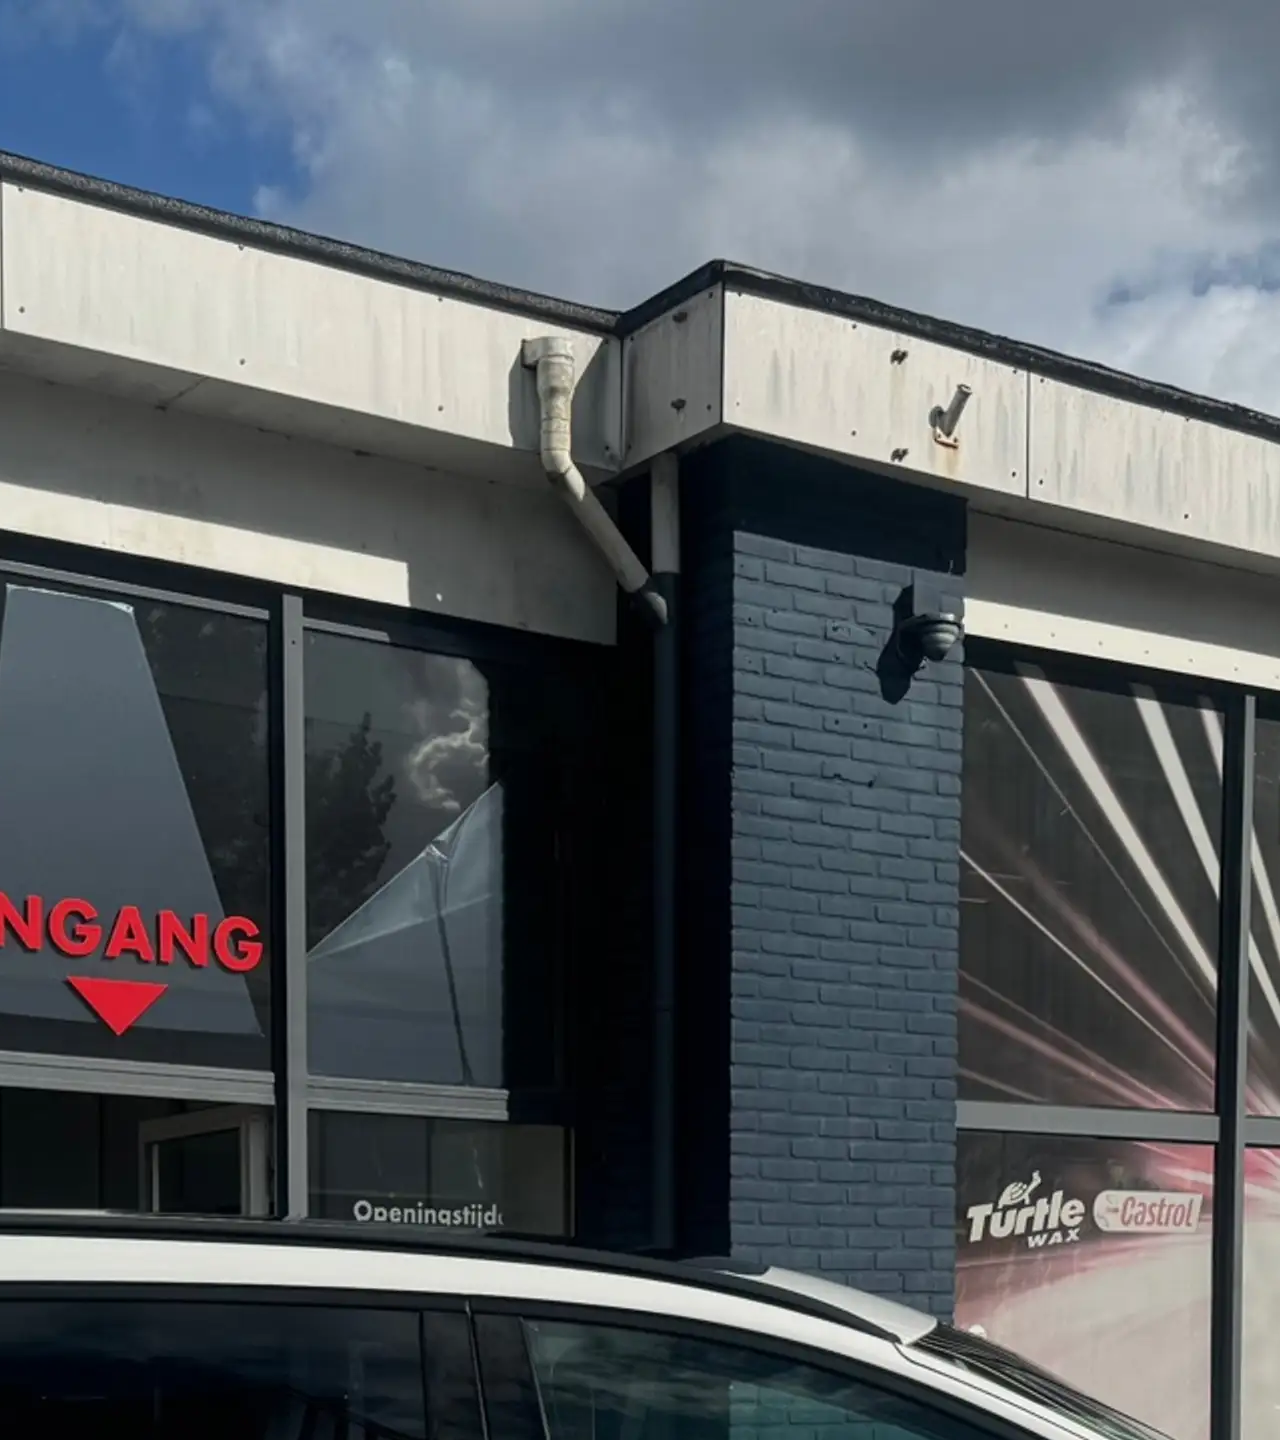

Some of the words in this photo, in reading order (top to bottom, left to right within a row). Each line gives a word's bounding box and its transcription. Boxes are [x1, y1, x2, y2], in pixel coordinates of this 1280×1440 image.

[966, 1190, 1086, 1243] Turtle
[1120, 1196, 1193, 1228] Castrol
[1027, 1229, 1080, 1248] WAX
